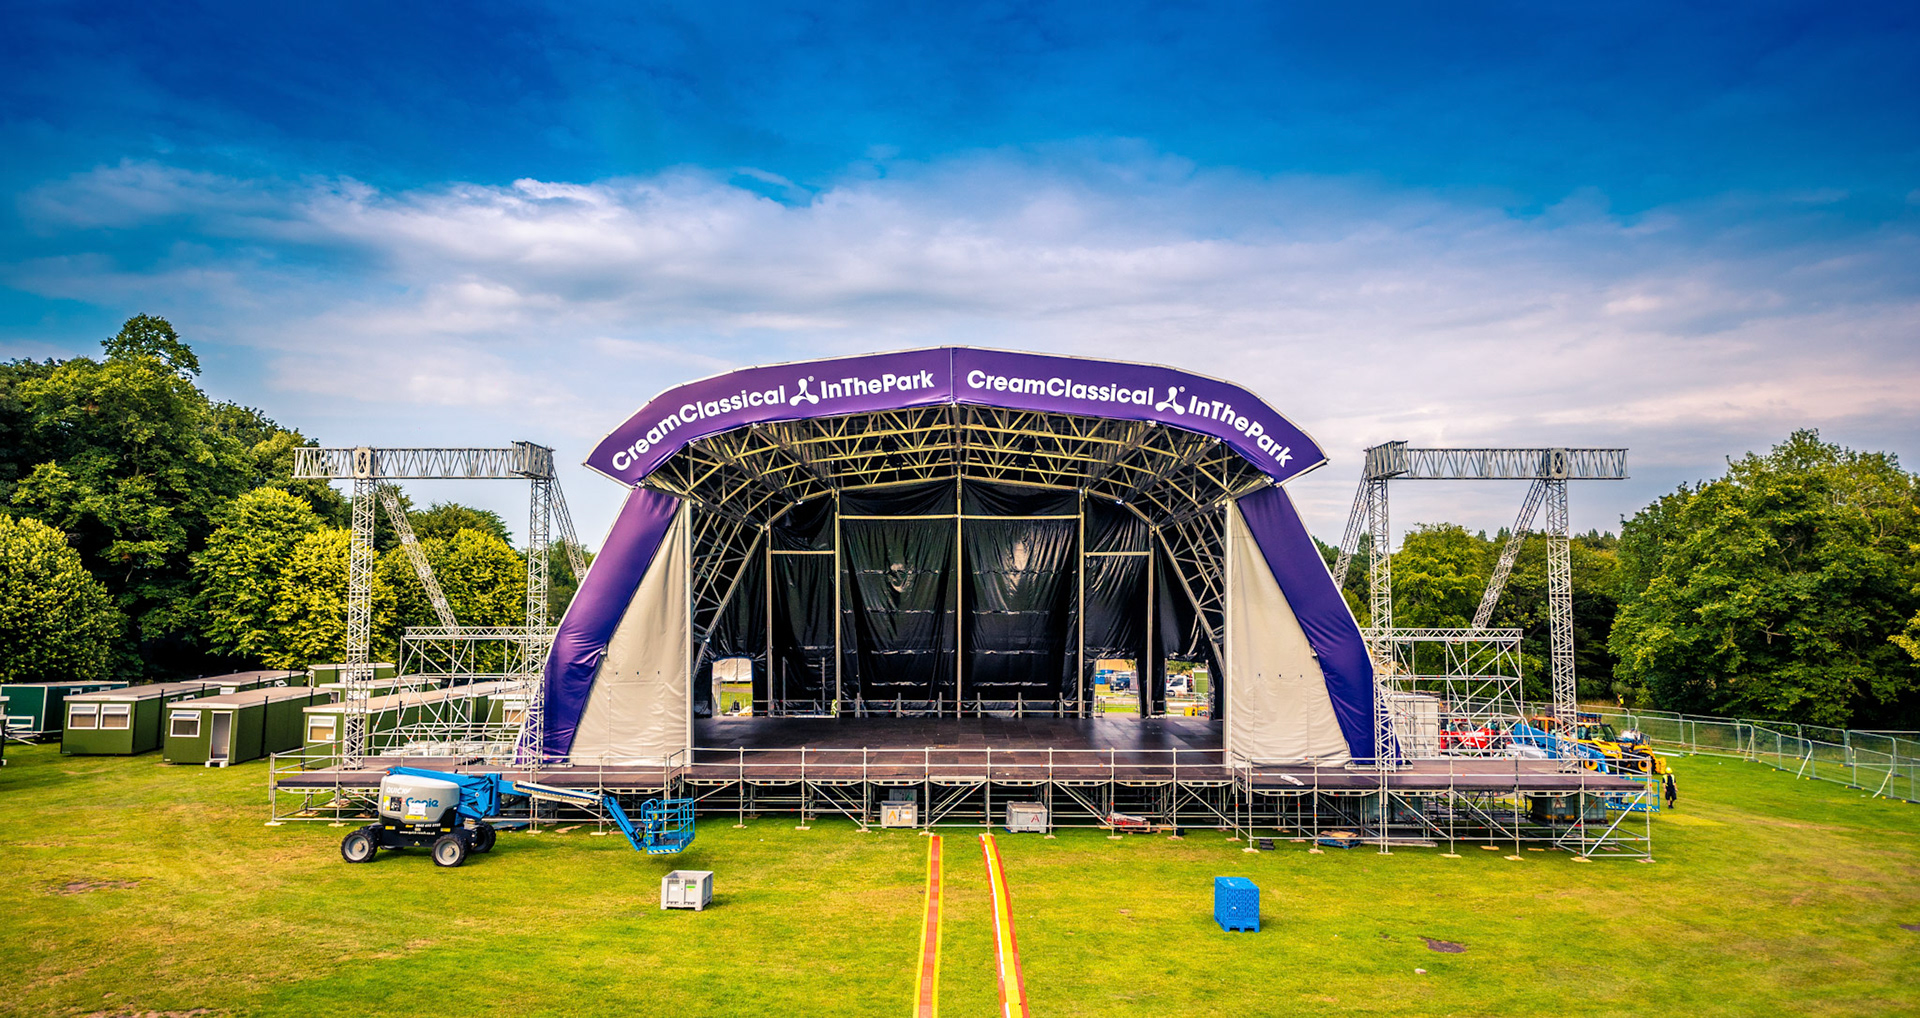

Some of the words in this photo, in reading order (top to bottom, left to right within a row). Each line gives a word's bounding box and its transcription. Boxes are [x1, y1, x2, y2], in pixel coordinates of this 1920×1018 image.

[612, 385, 786, 471] CreamClassical
[820, 369, 935, 400] InThePark
[966, 369, 1154, 407] CreamClassical
[1189, 395, 1293, 468] InThePark
